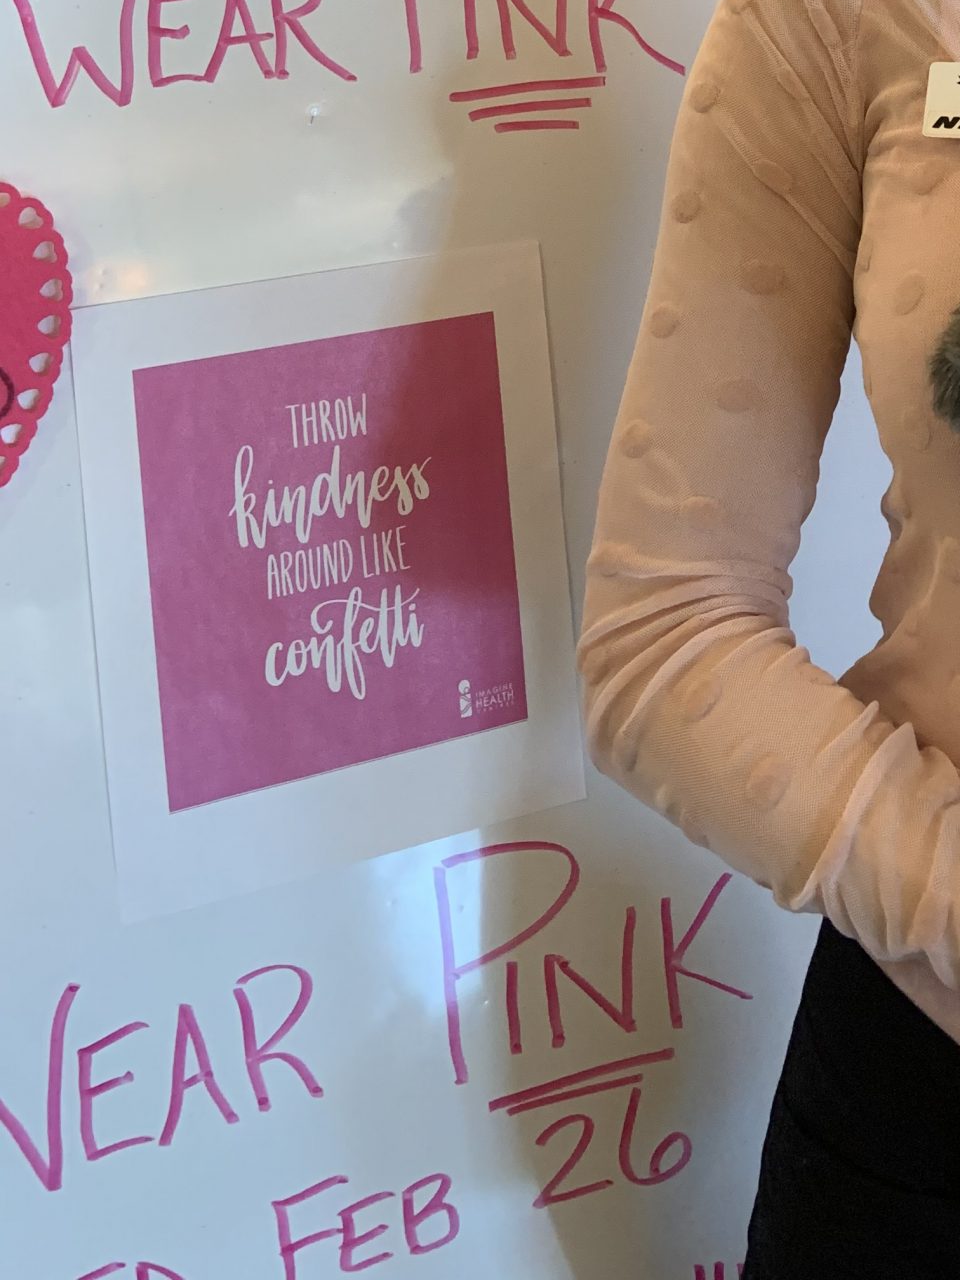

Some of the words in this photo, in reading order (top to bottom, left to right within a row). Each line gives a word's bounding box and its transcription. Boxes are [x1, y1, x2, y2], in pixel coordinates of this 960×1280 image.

[286, 393, 368, 448] THROW
[229, 445, 432, 548] kindness
[267, 539, 354, 599] AROUND
[359, 525, 411, 579] LIKE
[264, 587, 425, 700] confetti
[475, 689, 514, 708] HEALTH
[434, 841, 753, 1085] PINK
[271, 1173, 460, 1280] FEB
[533, 1087, 692, 1209] 26
